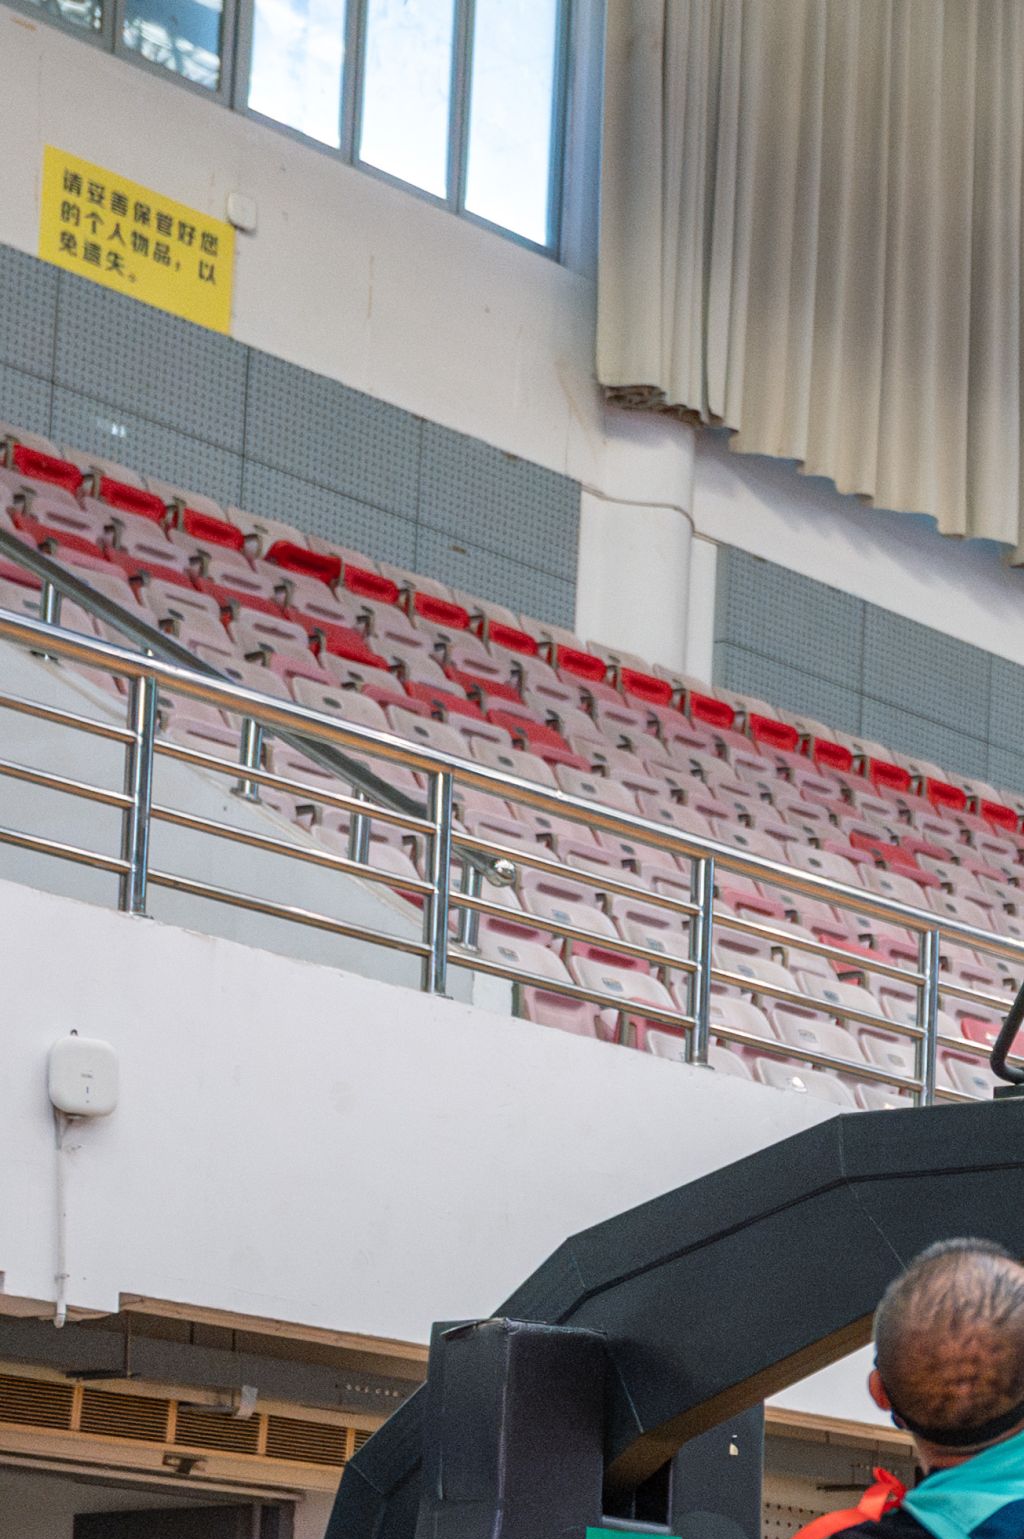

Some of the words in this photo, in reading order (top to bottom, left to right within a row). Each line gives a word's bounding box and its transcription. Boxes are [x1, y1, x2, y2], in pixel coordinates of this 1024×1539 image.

[60, 200, 216, 285] 的个人物品，以
[63, 167, 219, 257] 请妥善保管好您
